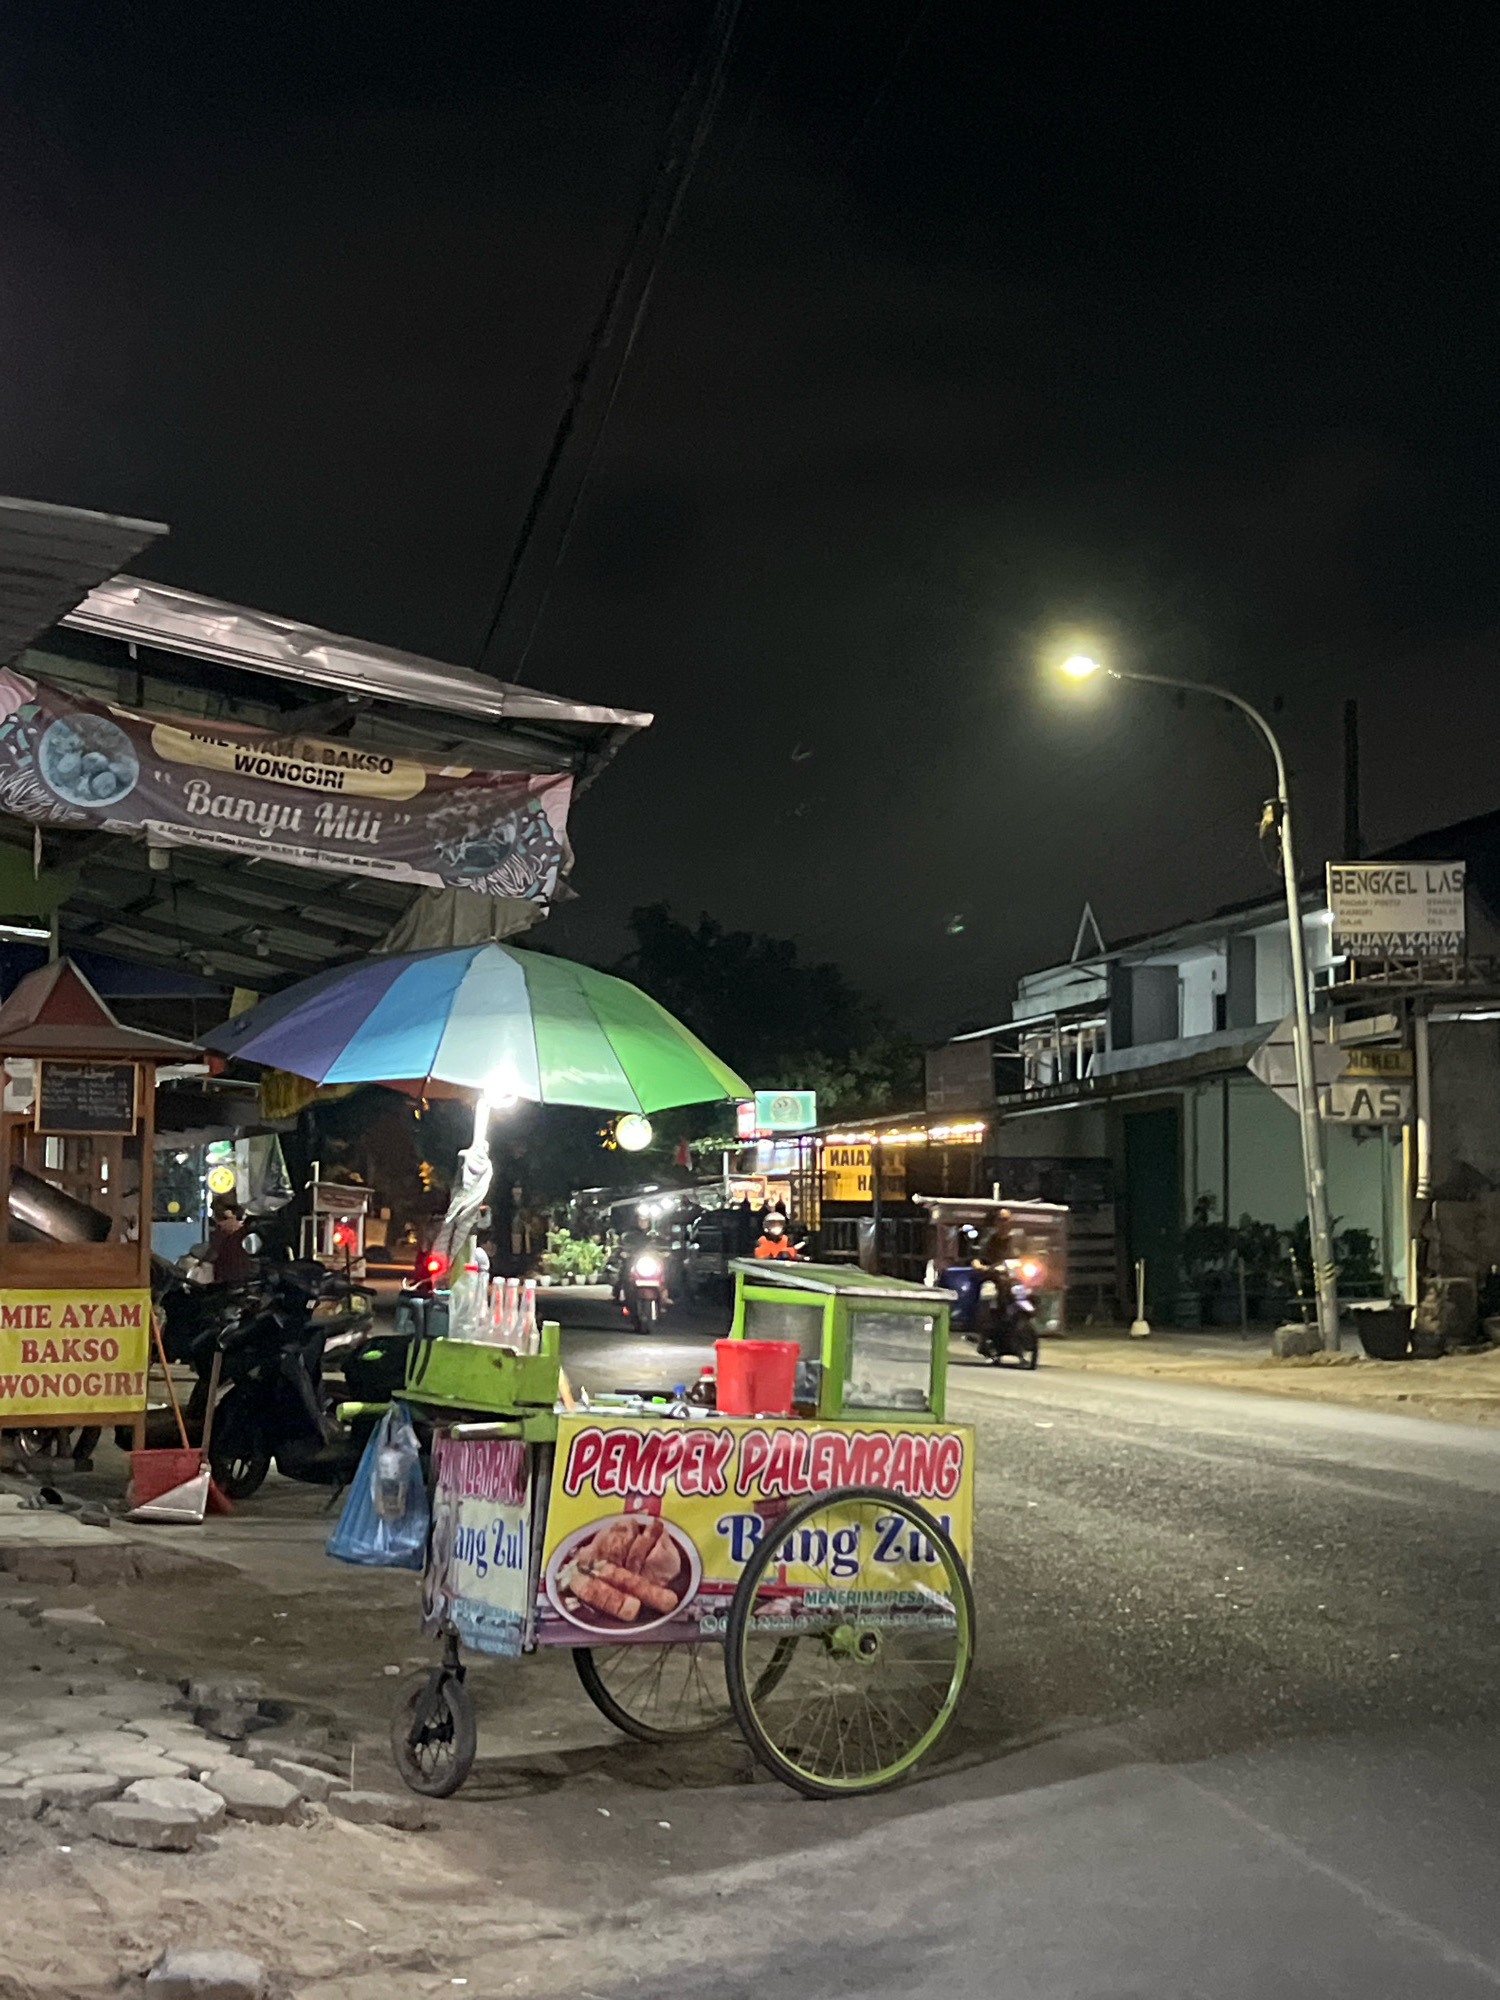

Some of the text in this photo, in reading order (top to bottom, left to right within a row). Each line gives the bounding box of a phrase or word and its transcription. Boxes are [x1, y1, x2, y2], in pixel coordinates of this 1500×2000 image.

[234, 754, 345, 789] WONOGIRI
[322, 748, 394, 775] BAKSO
[183, 779, 382, 844] Banyu Mili
[1332, 869, 1465, 894] BENGKEL LAS
[1325, 1087, 1401, 1118] LAS
[1, 1304, 142, 1329] MIE AYAM
[21, 1338, 119, 1364] BAKSO
[0, 1372, 144, 1398] WONOGIRI
[564, 1427, 964, 1499] PEMPEK PALEMBANG
[454, 1518, 524, 1579] ang Zul
[717, 1514, 861, 1578] Bang
